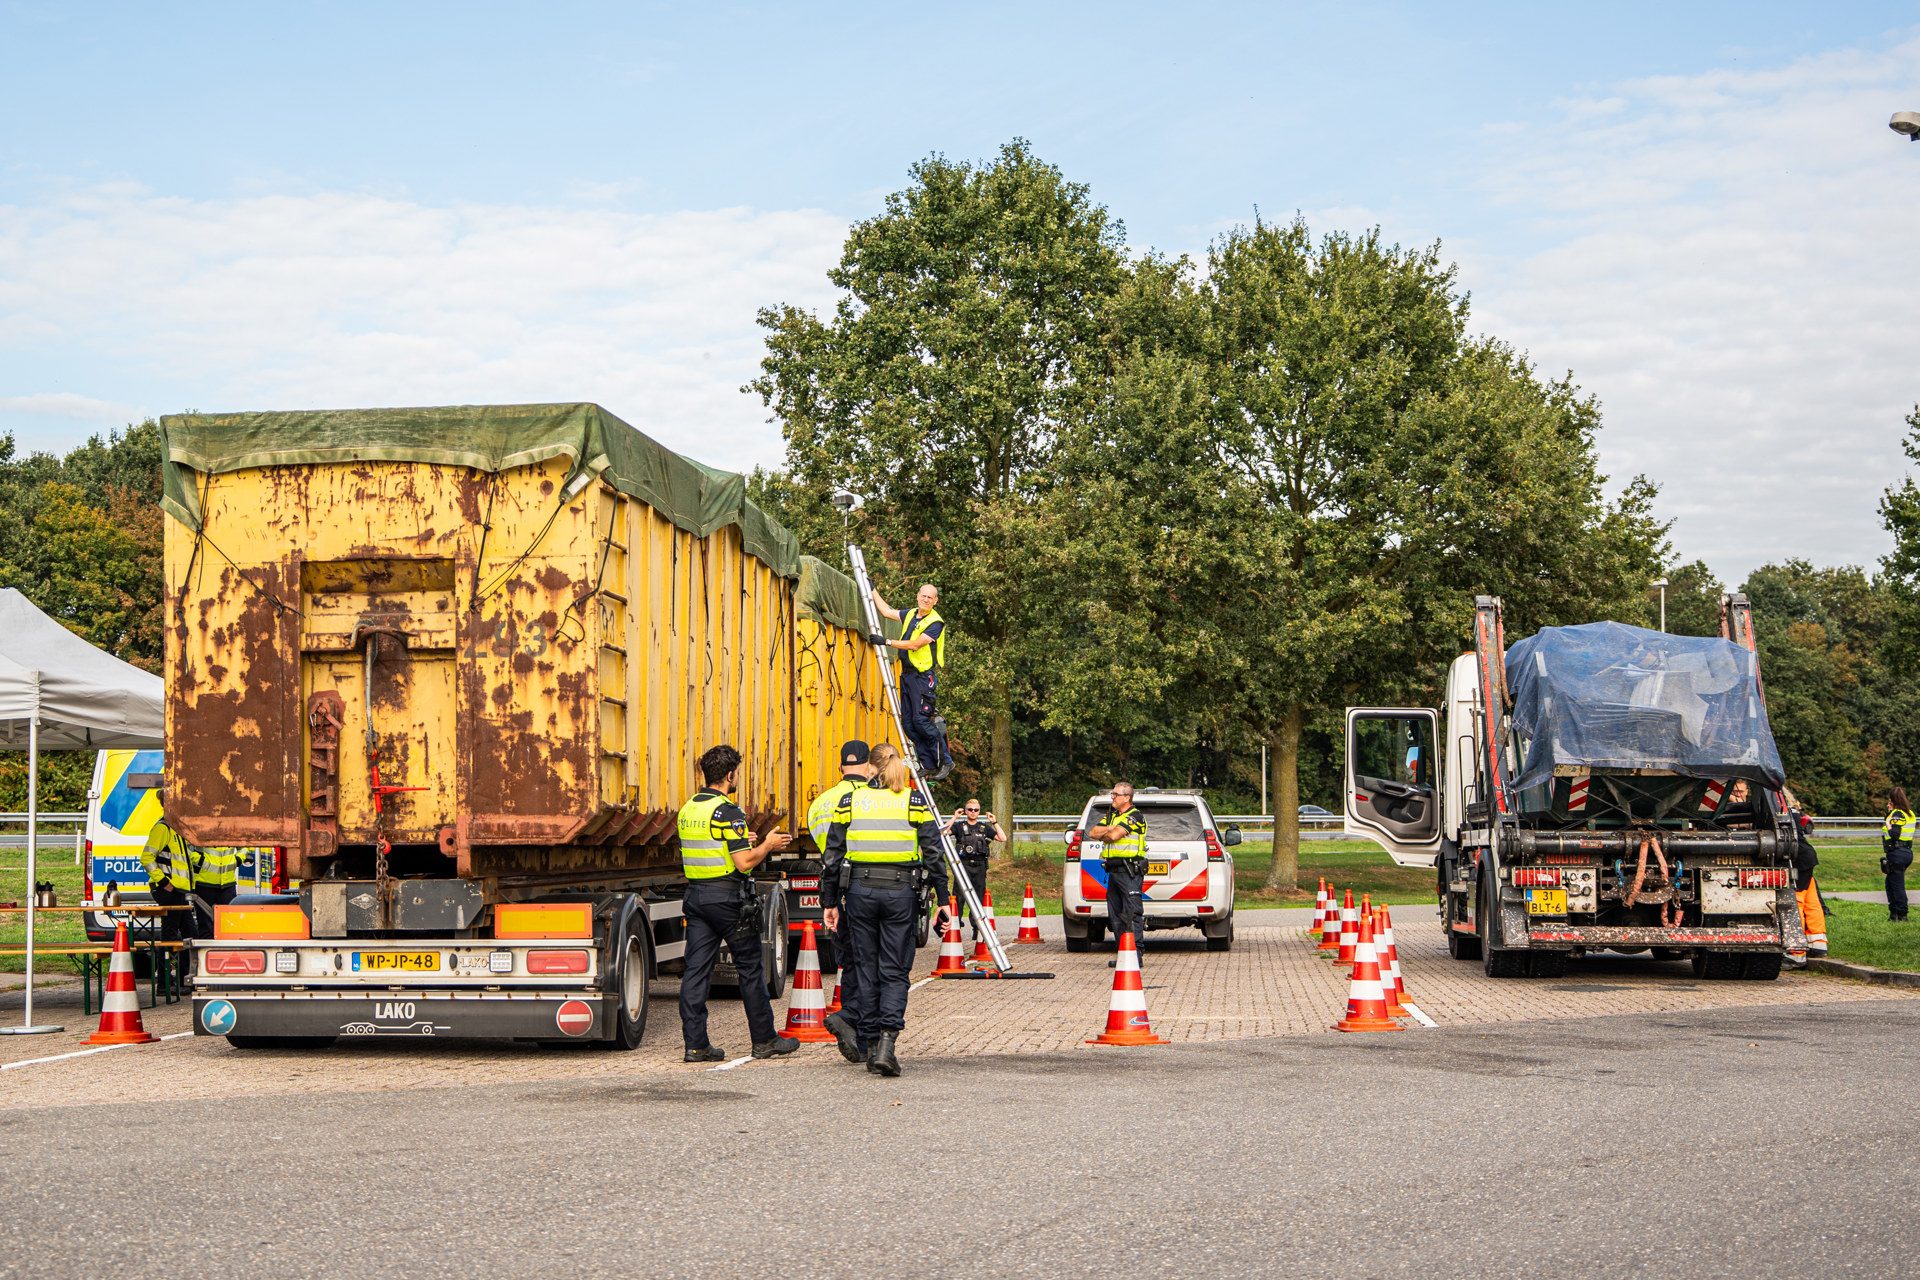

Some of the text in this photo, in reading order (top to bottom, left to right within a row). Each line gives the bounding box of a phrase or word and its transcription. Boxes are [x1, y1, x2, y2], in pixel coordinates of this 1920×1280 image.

[1717, 855, 1751, 865] FUTURA
[105, 861, 147, 873] POLIZ
[802, 896, 820, 906] LAK
[1543, 891, 1553, 901] 31
[1531, 903, 1562, 912] BLT-6
[366, 954, 433, 968] WP-JP-48
[460, 957, 488, 968] LAKO
[720, 952, 733, 964] LA
[375, 1002, 416, 1019] LAKO
